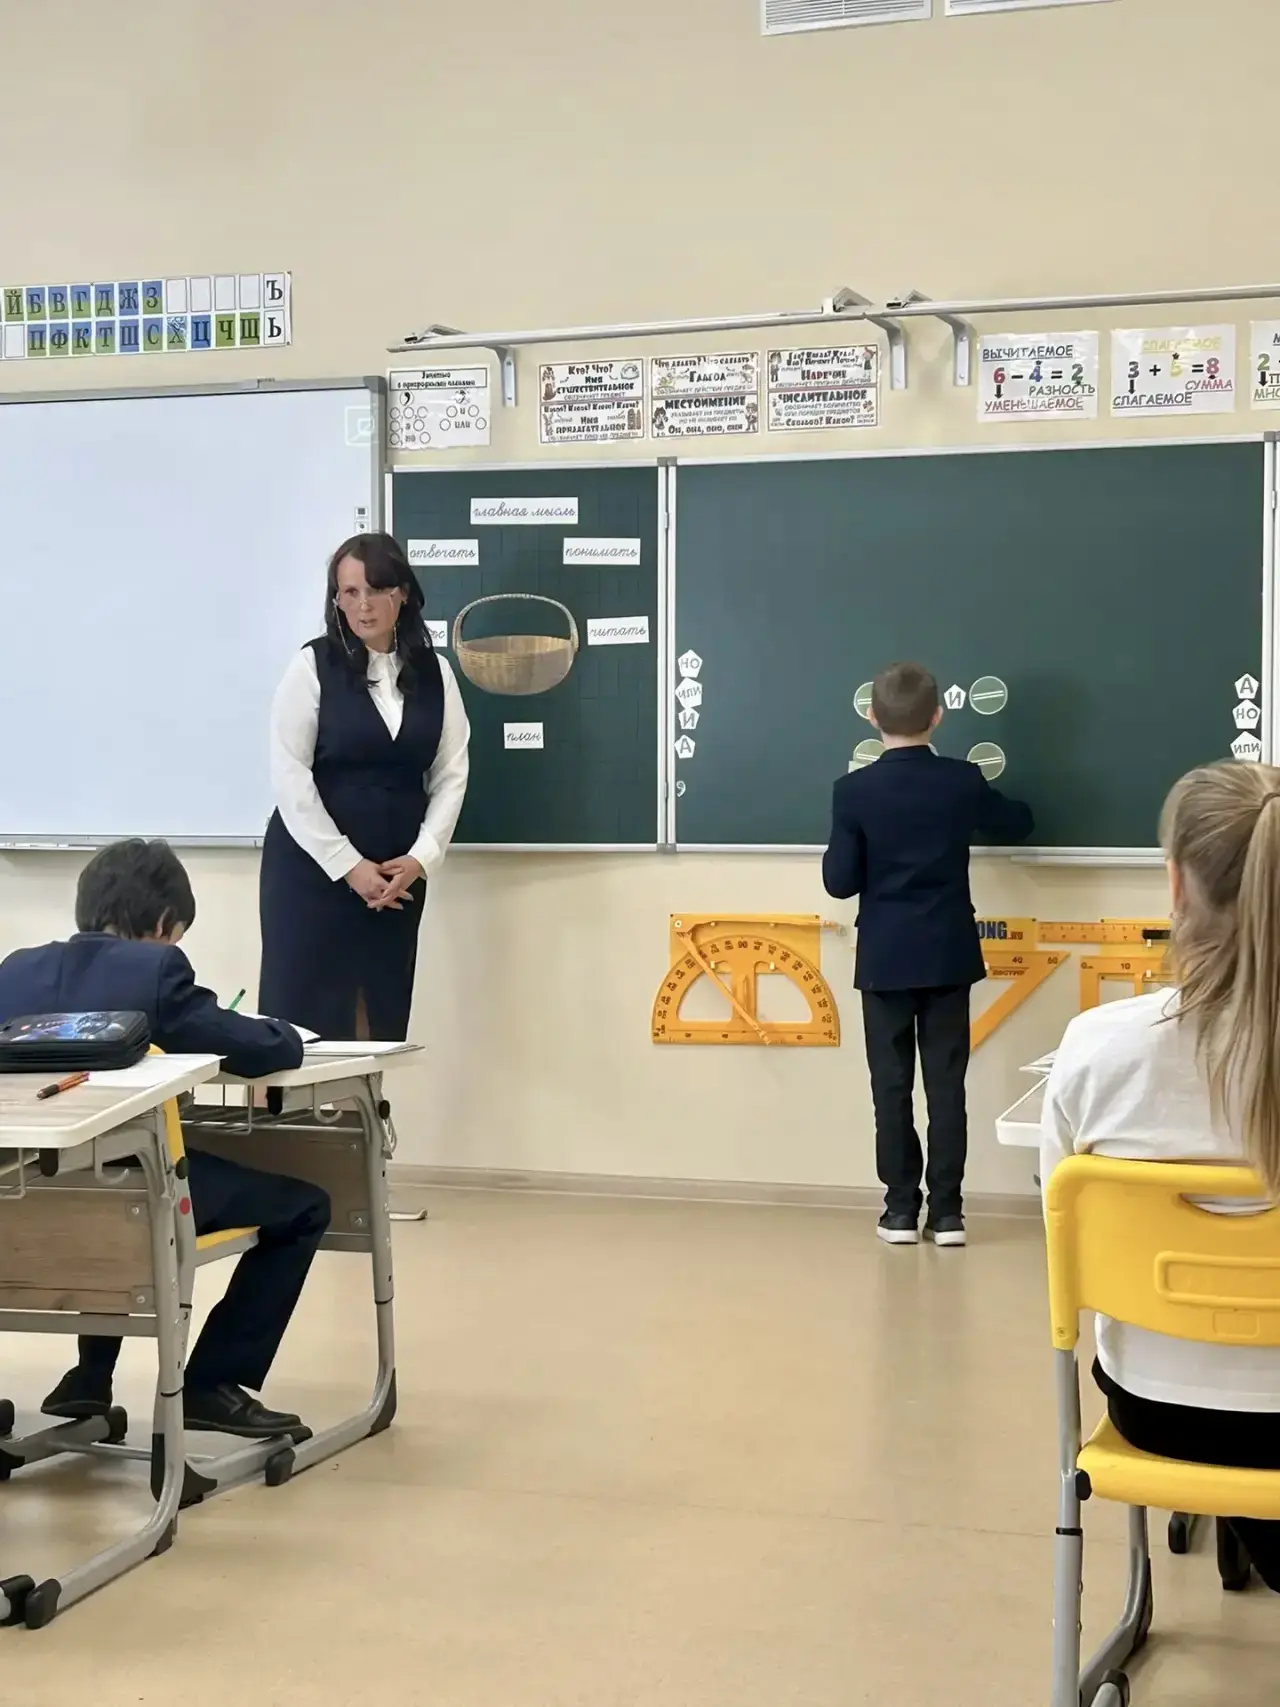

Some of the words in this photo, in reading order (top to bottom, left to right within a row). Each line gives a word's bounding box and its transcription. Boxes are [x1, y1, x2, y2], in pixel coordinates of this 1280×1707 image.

[7, 290, 23, 315] Й
[28, 294, 41, 314] Б
[52, 293, 65, 312] В
[75, 291, 87, 311] Г
[97, 290, 112, 316] Д
[119, 288, 138, 309] Ж
[146, 287, 158, 308] З
[266, 280, 283, 300] Ъ
[29, 330, 45, 350] П
[51, 329, 68, 348] Ф
[75, 328, 89, 348] К
[99, 327, 113, 347] Т
[120, 326, 139, 345] Ш
[147, 324, 159, 344] С
[193, 321, 210, 346] Ц
[218, 320, 234, 340] Ч
[240, 318, 260, 344] Щ
[268, 317, 282, 337] Ь
[982, 345, 1073, 359] ВЫЧИТАЕМОЕ
[1128, 361, 1139, 378] 3
[1206, 358, 1219, 375] 8
[1257, 353, 1270, 371] 2
[993, 367, 1005, 384] 6
[1029, 366, 1043, 382] 4
[1071, 363, 1084, 381] 2
[1029, 384, 1096, 396] РАЗНОСТЬ
[1185, 379, 1233, 391] СУММА
[665, 396, 746, 409] МЕСТОИМЕНИЕ
[985, 397, 1084, 411] УМЕНЬШАЕМОЕ
[1113, 392, 1193, 406] СЛАГАЕМОЕ
[473, 500, 528, 517] главная
[531, 506, 576, 517] мысль
[409, 544, 476, 558] отвечать
[565, 547, 637, 558] понимать
[589, 626, 647, 637] читать
[680, 658, 700, 669] НО
[1240, 677, 1254, 694] А
[949, 691, 962, 707] И
[683, 712, 695, 727] И
[1236, 707, 1258, 719] НО
[507, 732, 541, 742] план
[680, 738, 692, 754] А
[1234, 743, 1259, 754] ИЛИ
[1012, 956, 1023, 964] 40
